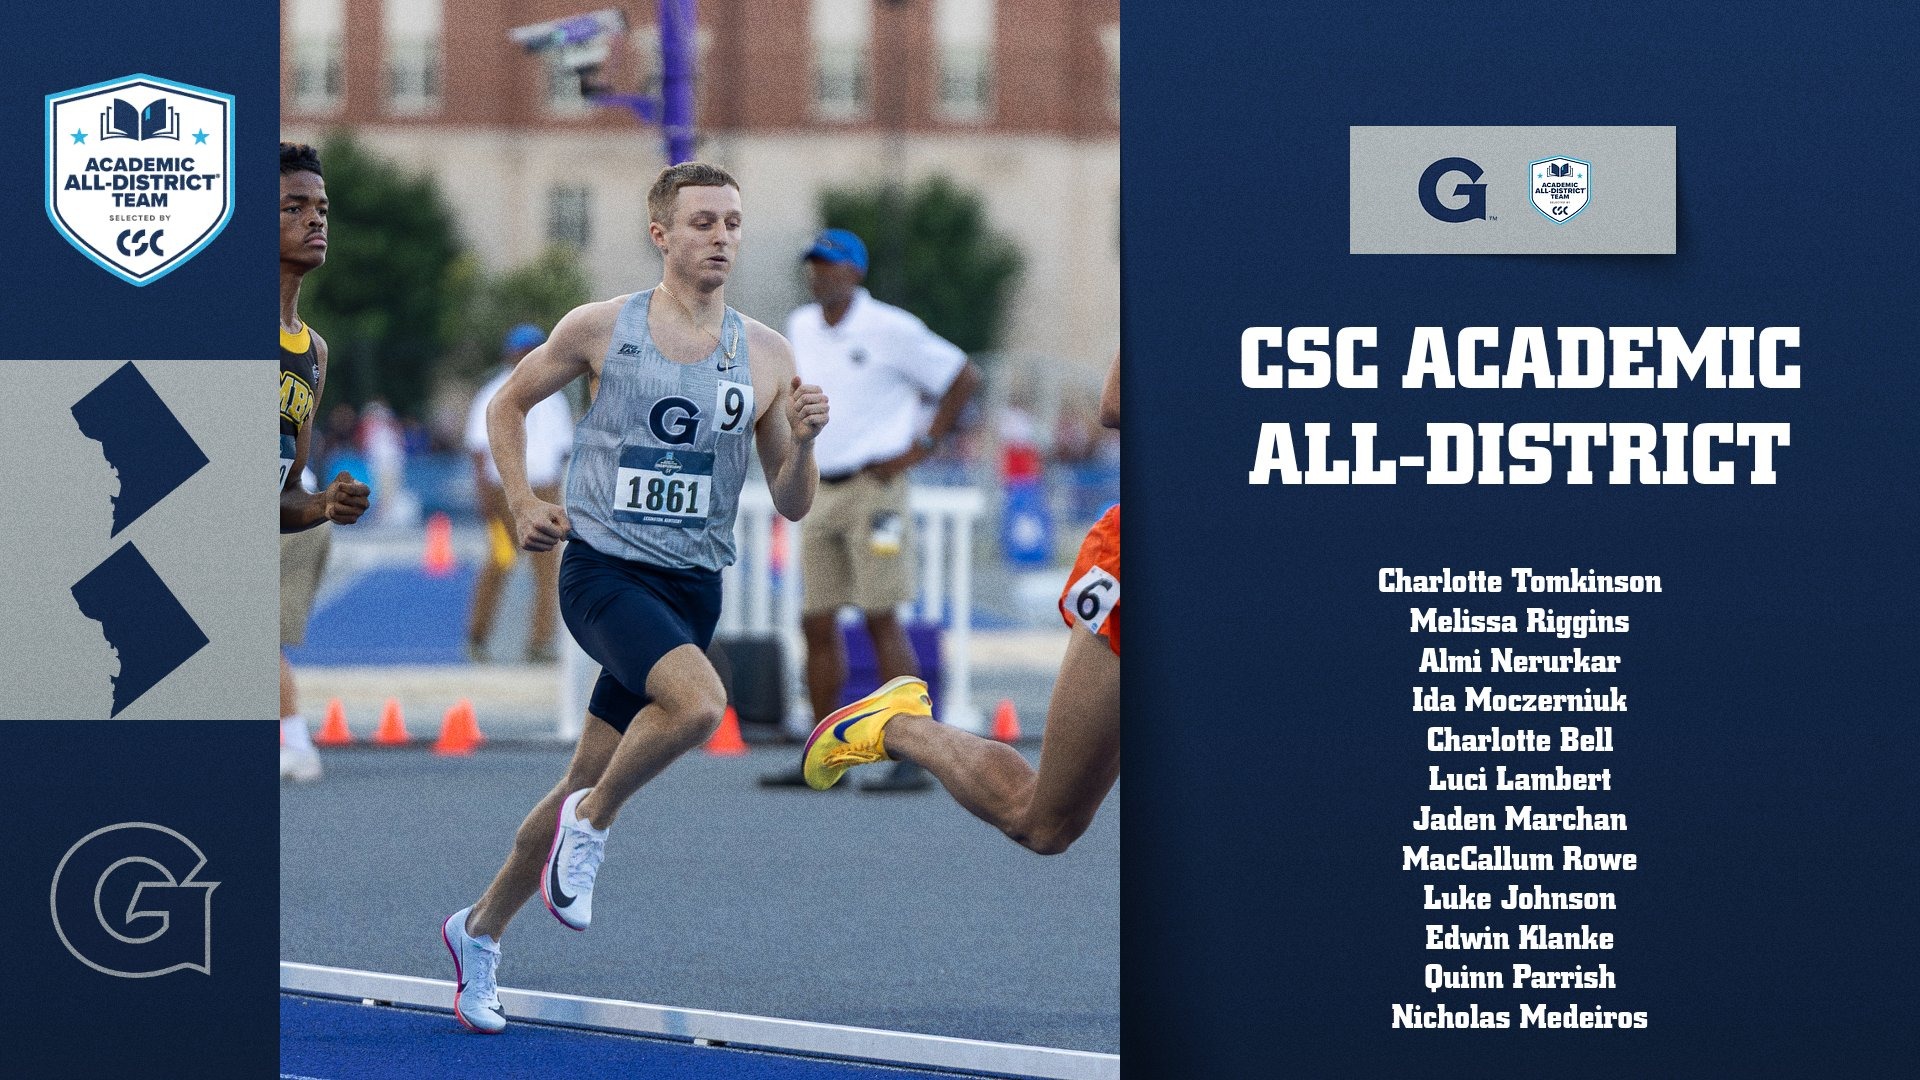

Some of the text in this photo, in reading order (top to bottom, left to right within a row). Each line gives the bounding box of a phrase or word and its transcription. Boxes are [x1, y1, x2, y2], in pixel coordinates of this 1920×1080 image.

[648, 396, 701, 446] G
[721, 387, 744, 431] 9
[627, 476, 698, 513] 1861
[1077, 578, 1112, 620] 6
